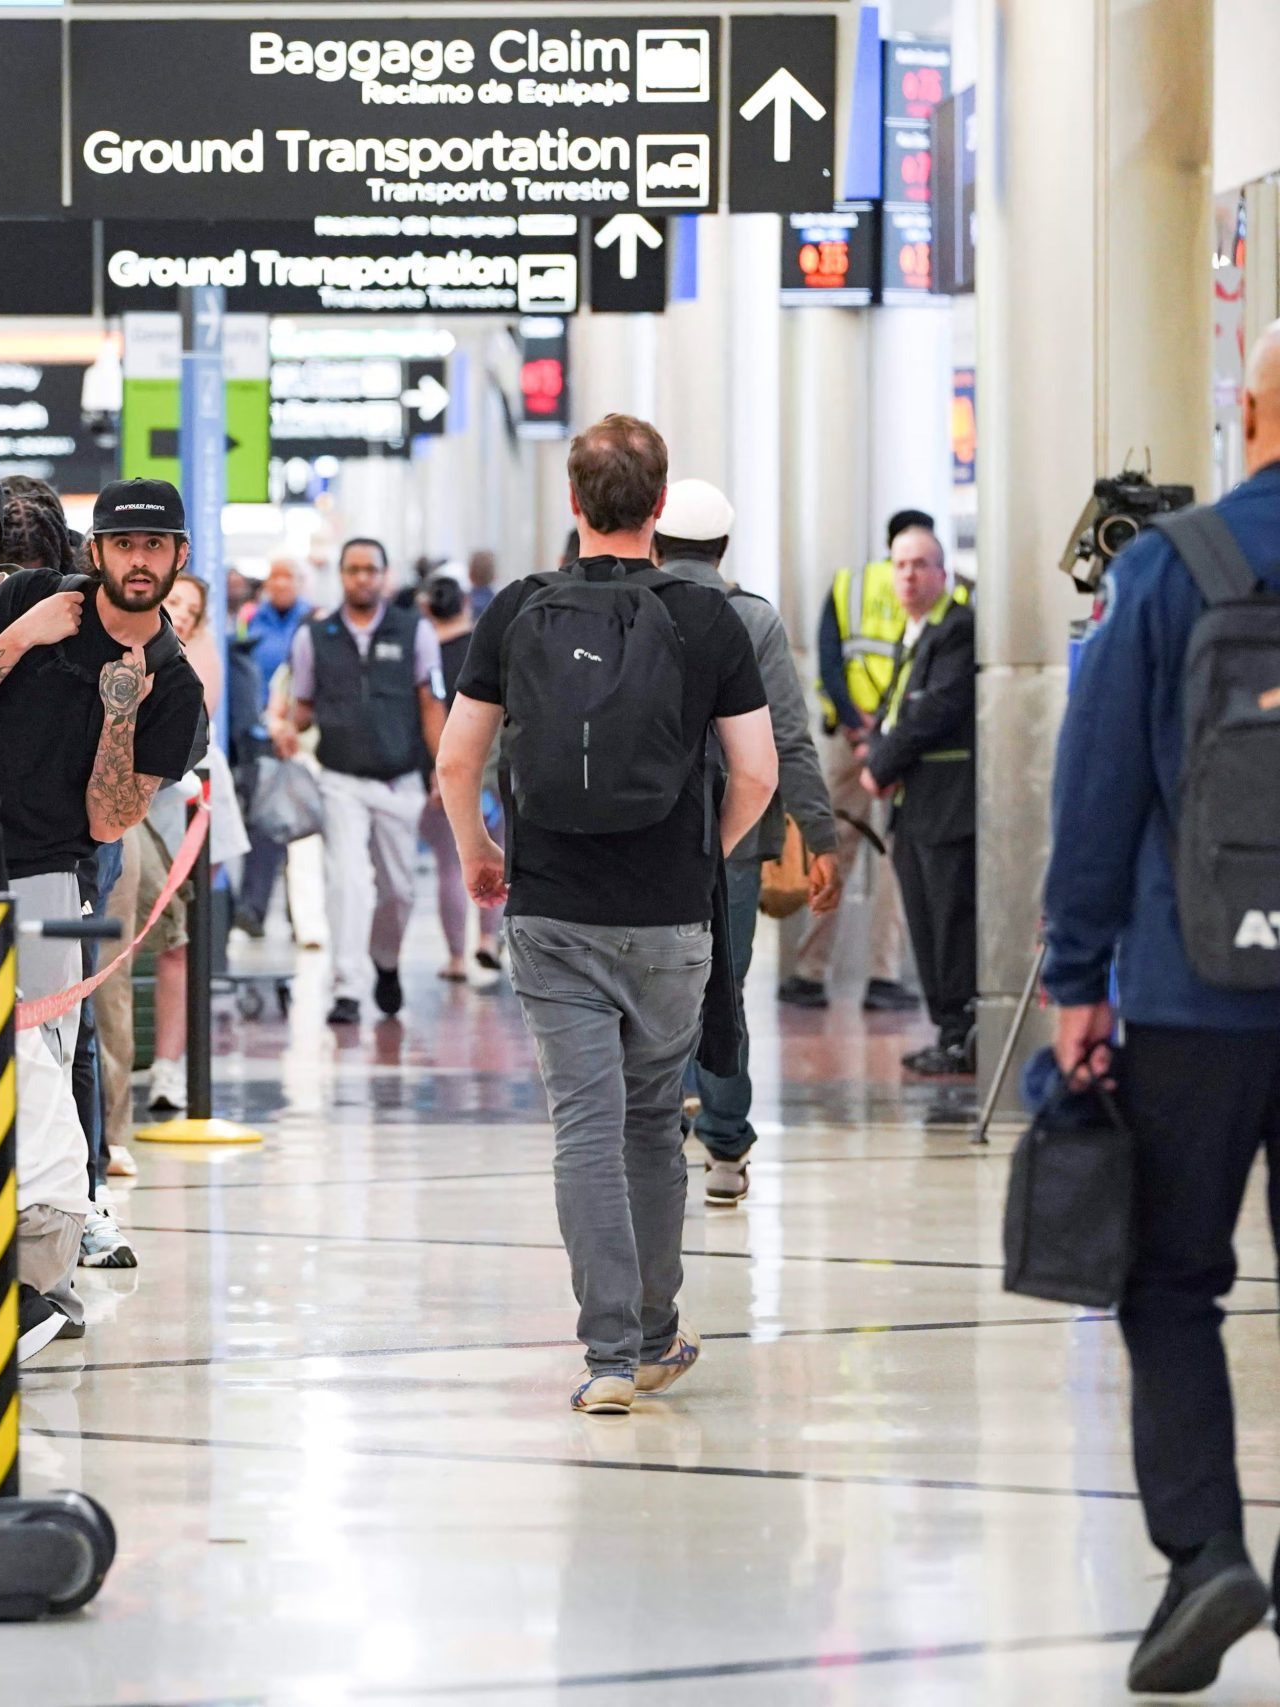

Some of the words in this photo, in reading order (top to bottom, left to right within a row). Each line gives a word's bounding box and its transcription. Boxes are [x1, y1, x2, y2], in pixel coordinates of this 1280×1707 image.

[249, 31, 476, 81] Baggage
[488, 28, 631, 73] Claim
[356, 79, 475, 105] Reclamo
[477, 79, 514, 105] de
[517, 79, 631, 107] Equipaje
[82, 128, 264, 174] Ground
[275, 127, 631, 177] Transportation
[365, 177, 508, 206] Transporte
[510, 176, 630, 202] Terrestre
[107, 248, 247, 288] Ground
[249, 247, 518, 291] Transportation
